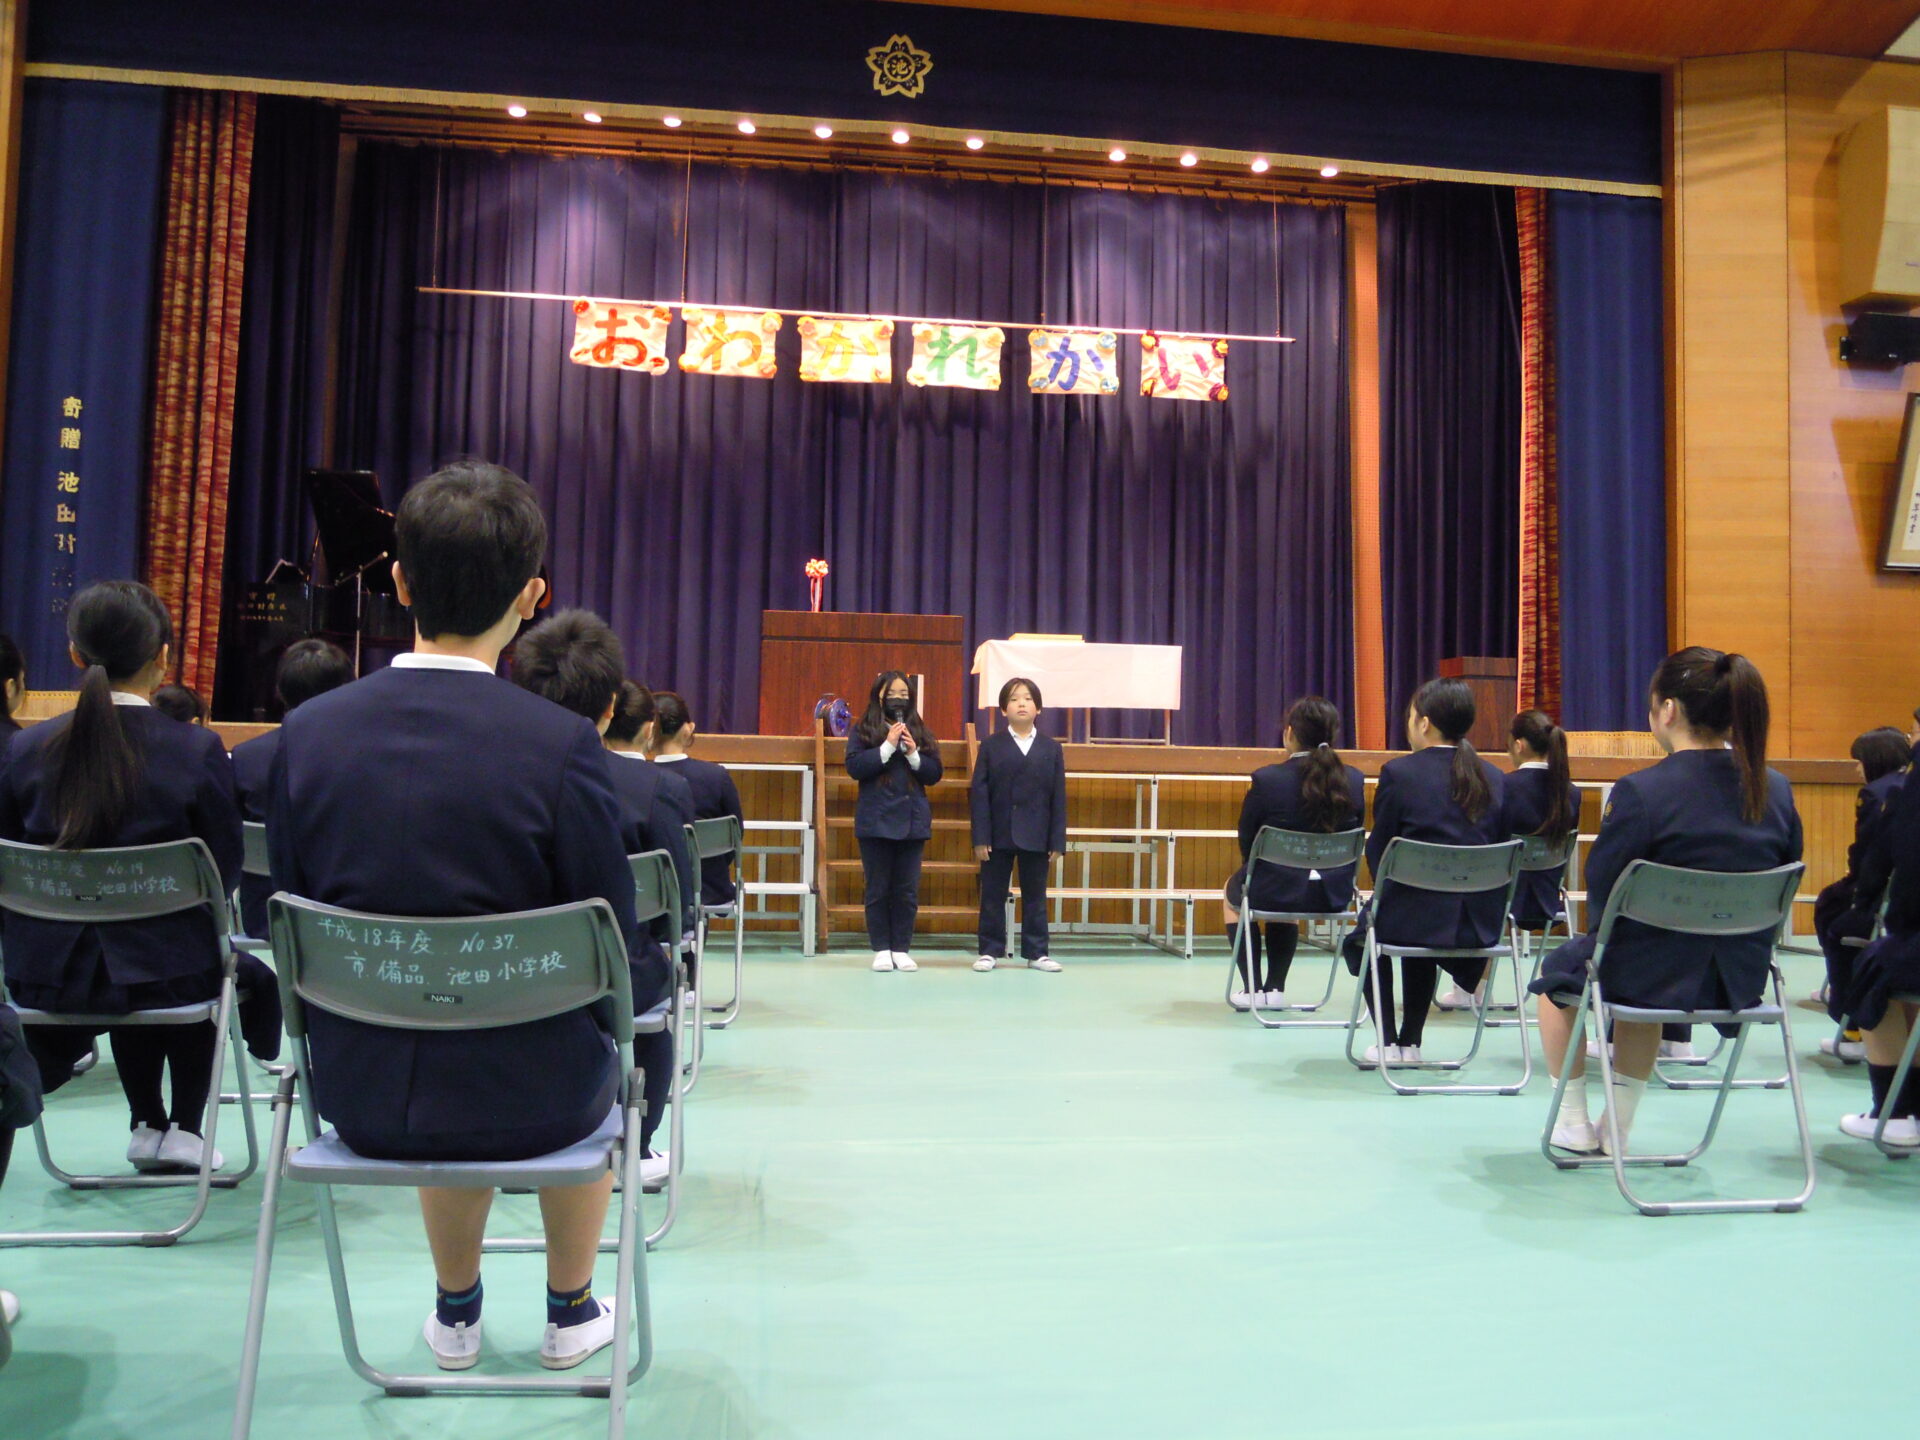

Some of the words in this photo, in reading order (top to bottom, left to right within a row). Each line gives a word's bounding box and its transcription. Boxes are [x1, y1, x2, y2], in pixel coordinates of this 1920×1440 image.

[96, 875, 181, 895] 池田小学校
[317, 918, 434, 955] 平成18年度
[447, 950, 567, 986] 池田小学校
[431, 994, 455, 1003] NAIKI
